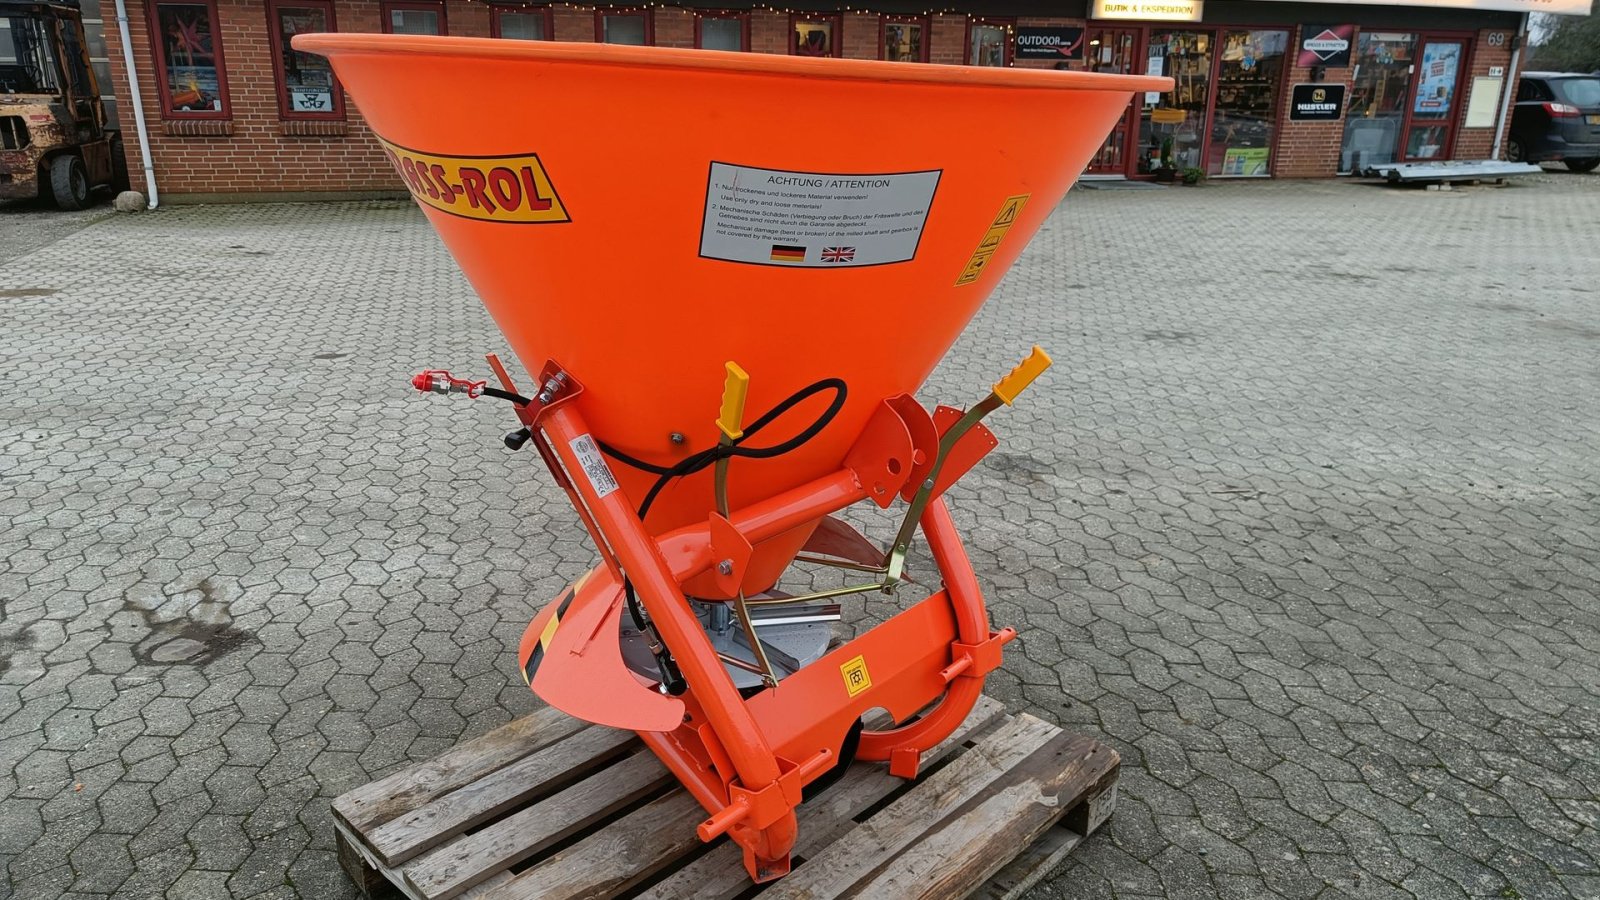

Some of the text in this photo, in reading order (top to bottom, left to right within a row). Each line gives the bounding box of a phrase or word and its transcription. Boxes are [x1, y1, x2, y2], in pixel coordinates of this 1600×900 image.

[1141, 5, 1193, 14] EKSPEDITION
[1018, 35, 1060, 45] OUTDOOR
[1488, 32, 1504, 46] 69
[768, 176, 822, 188] ACHTUNG
[831, 180, 890, 188] ATTENTION
[736, 187, 766, 195] trockenes
[720, 205, 760, 216] Mechanische
[762, 210, 788, 218] Schäden
[719, 212, 748, 222] Getriebes
[717, 222, 753, 231] Mechanical
